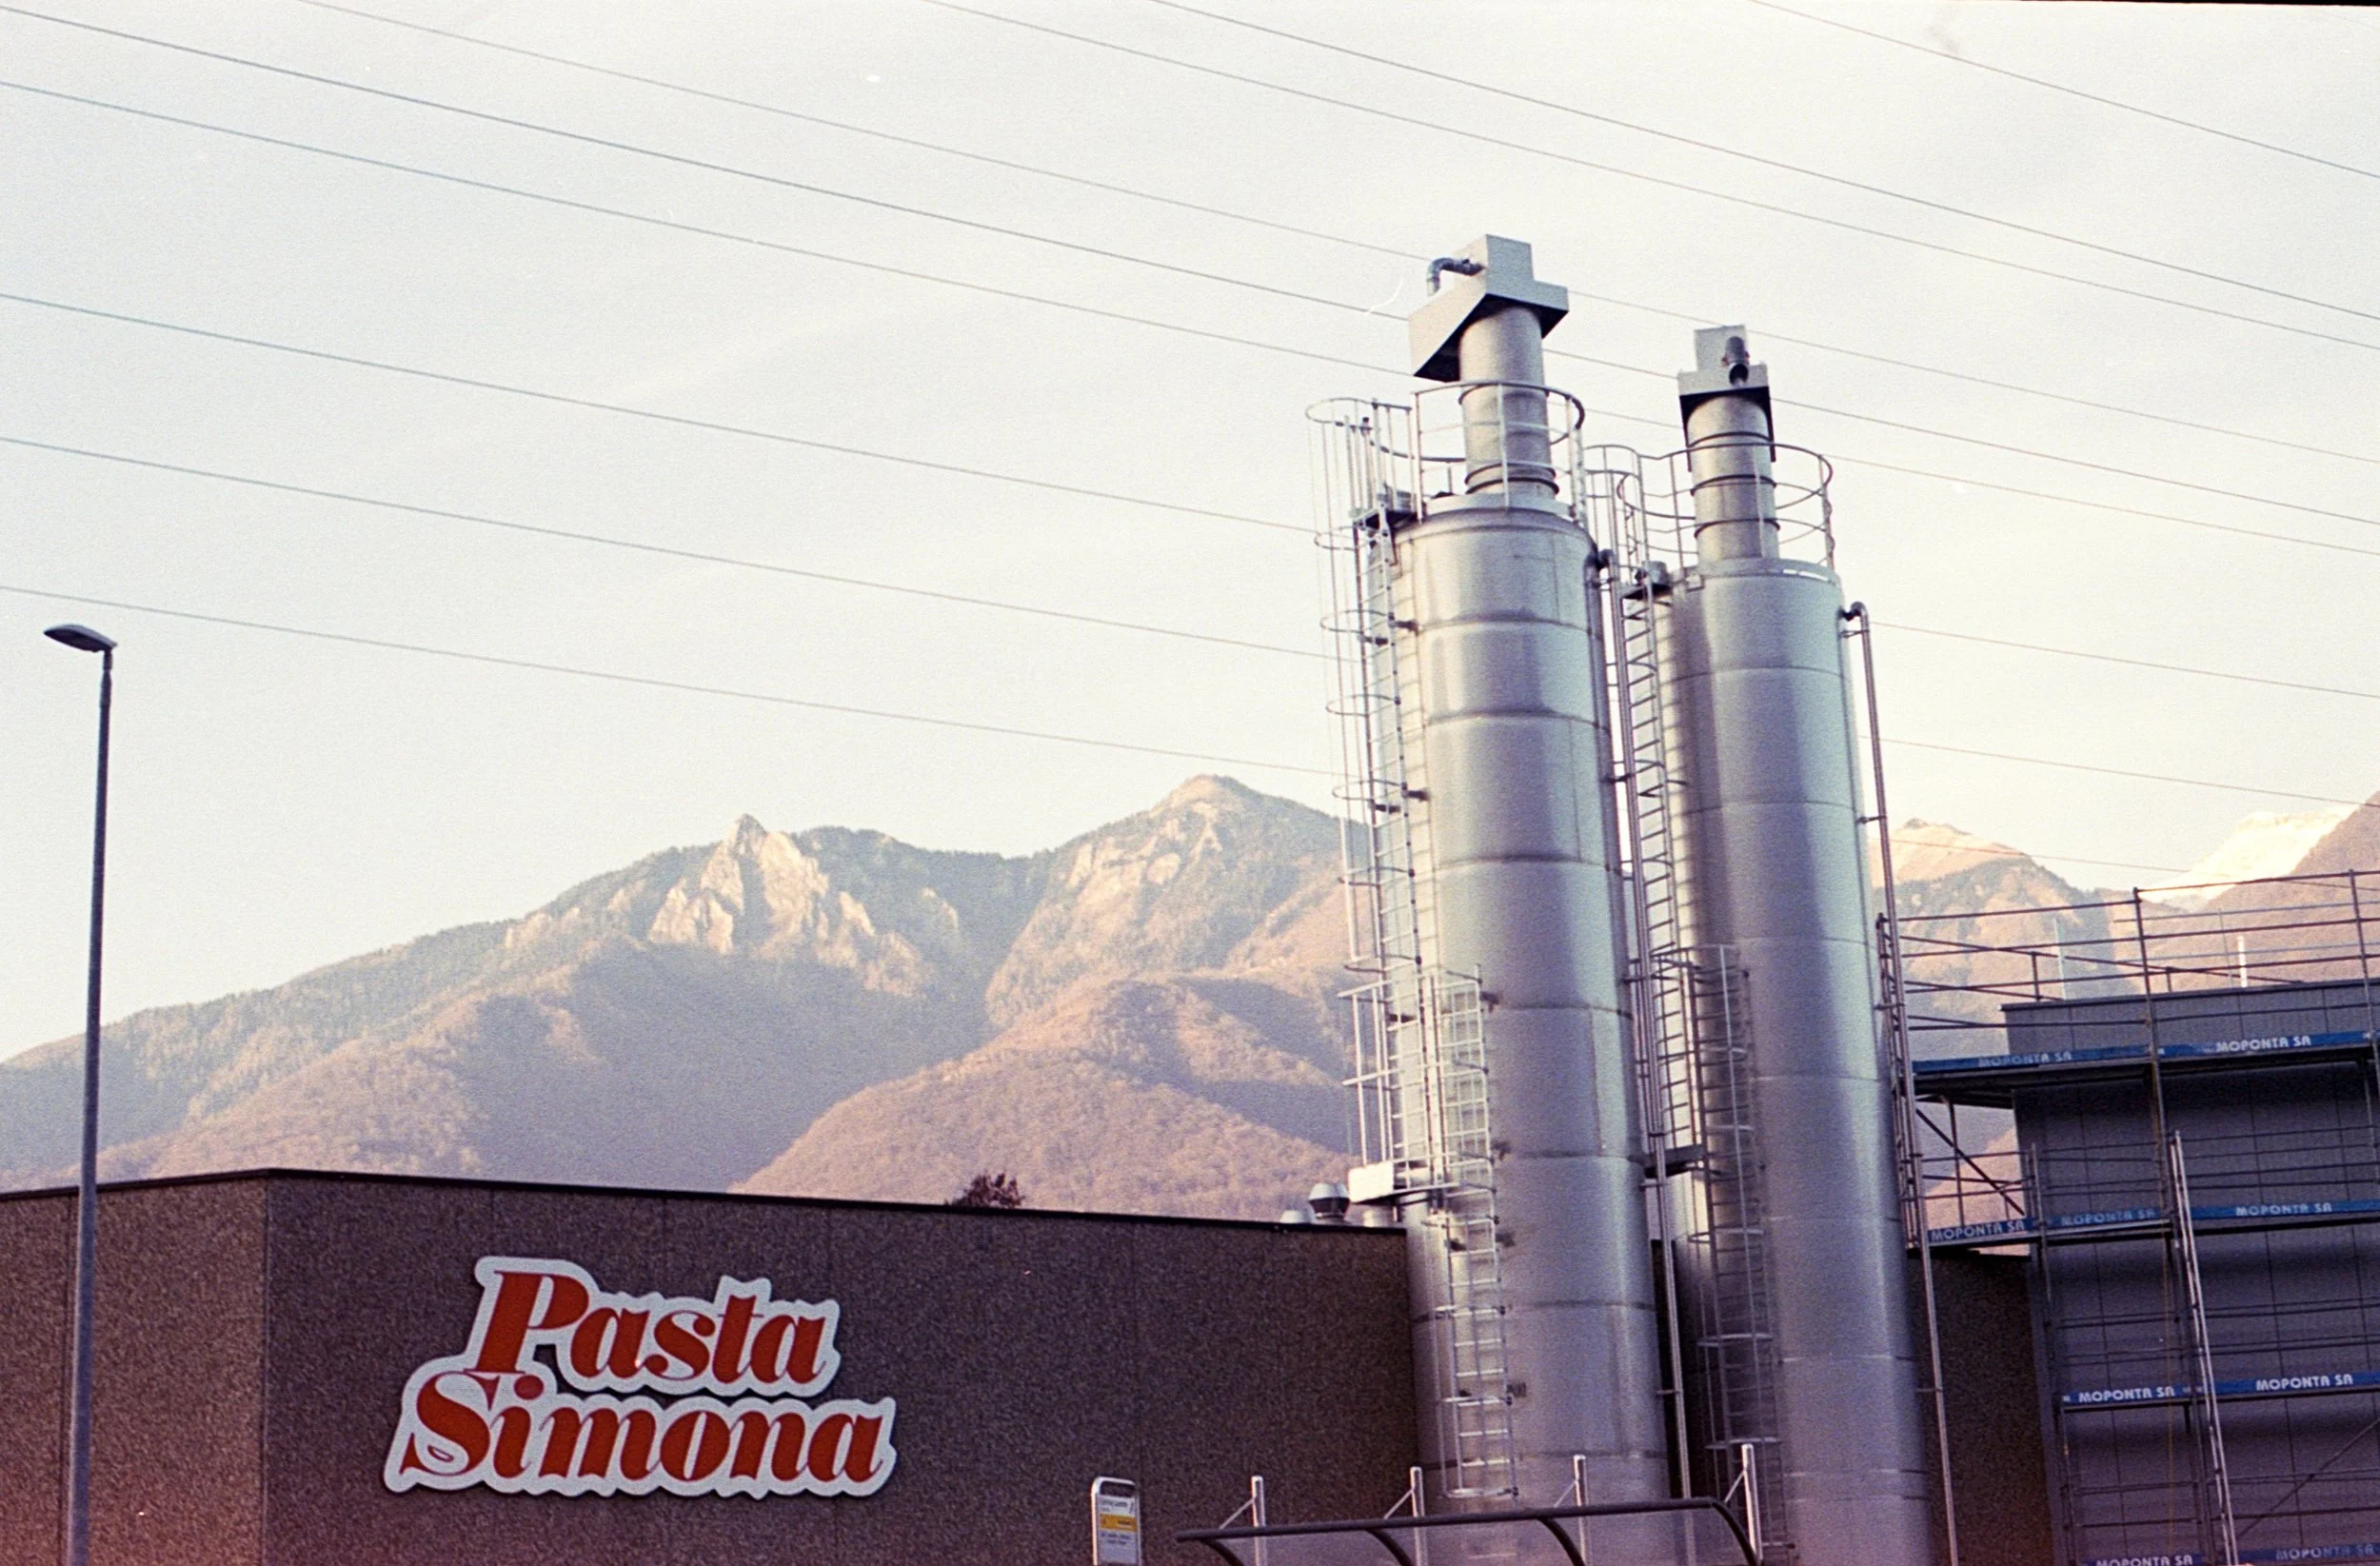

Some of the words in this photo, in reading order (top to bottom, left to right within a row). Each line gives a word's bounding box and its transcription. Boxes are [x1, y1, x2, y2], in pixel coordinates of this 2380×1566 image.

[2216, 1037, 2289, 1052] MOPONTA
[2293, 1036, 2311, 1047] SA
[1978, 1052, 2049, 1067] MOPONTA
[2055, 1051, 2072, 1062] SA
[2137, 1208, 2156, 1219] SA
[2235, 1203, 2309, 1217] MOPONTA
[2314, 1202, 2332, 1214] SA
[1932, 1222, 2003, 1241] MOPONTA
[2008, 1220, 2025, 1233] SA
[464, 1269, 827, 1384] Pasta
[2256, 1375, 2330, 1391] MOPONTA
[2334, 1374, 2353, 1385] SA
[2078, 1387, 2152, 1402] MOPONTA
[2156, 1386, 2175, 1398] SA
[399, 1371, 884, 1483] Simona
[2276, 1545, 2350, 1560] MOPONTA
[2355, 1543, 2374, 1555] SA
[2096, 1556, 2171, 1566] MOPONTA
[2174, 1555, 2193, 1565] SA
